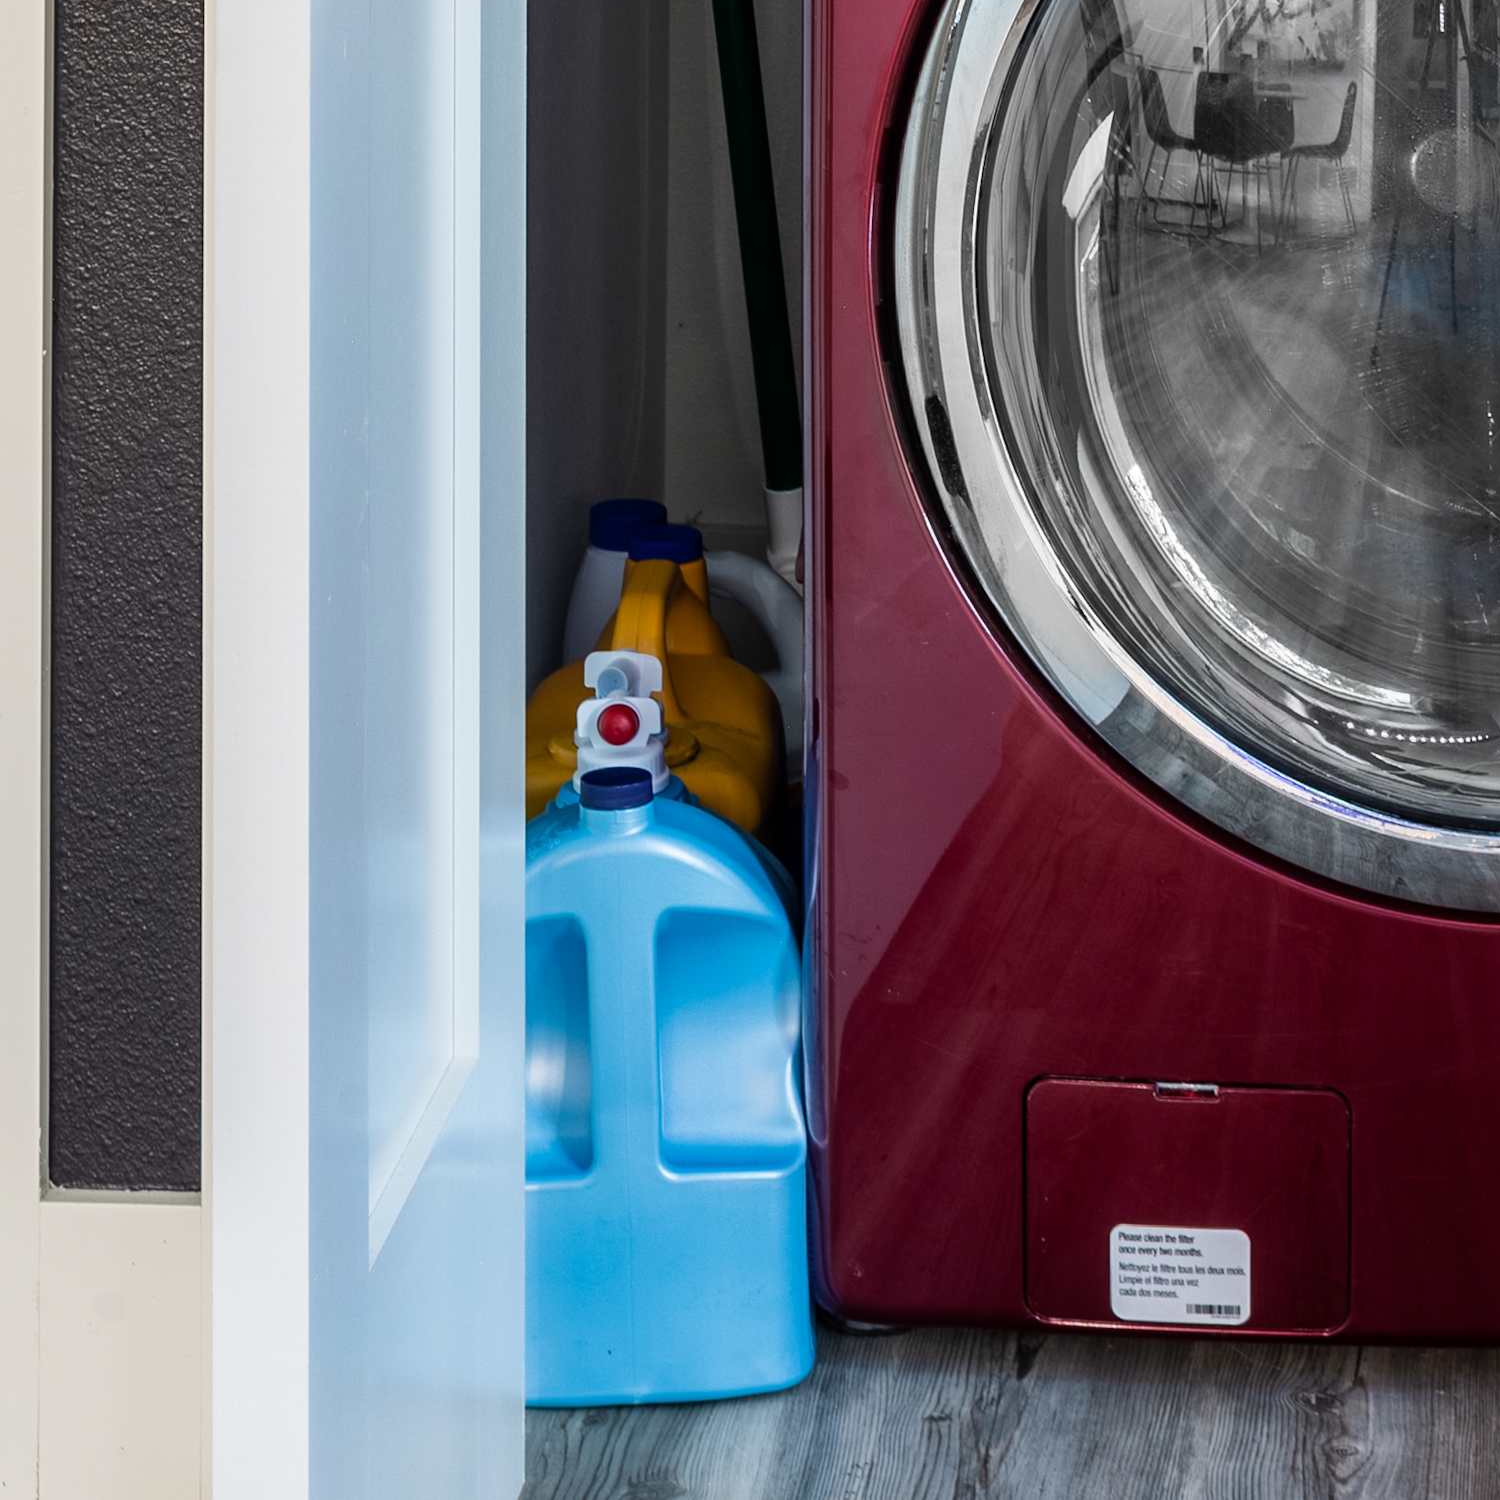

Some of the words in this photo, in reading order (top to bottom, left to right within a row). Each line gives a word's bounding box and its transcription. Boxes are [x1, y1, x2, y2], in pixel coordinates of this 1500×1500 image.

[1119, 1232, 1142, 1242] Please
[1144, 1233, 1164, 1243] clean
[1165, 1234, 1177, 1243] the
[1178, 1234, 1195, 1244] filter
[1119, 1246, 1136, 1254] once
[1138, 1247, 1158, 1257] every
[1160, 1247, 1173, 1256] two
[1119, 1262, 1150, 1273] Nettoyez
[1160, 1264, 1176, 1274] filtre
[1178, 1265, 1193, 1274] tous
[1208, 1266, 1225, 1275] deux
[1119, 1288, 1137, 1297] cada
[1139, 1289, 1152, 1297] dos
